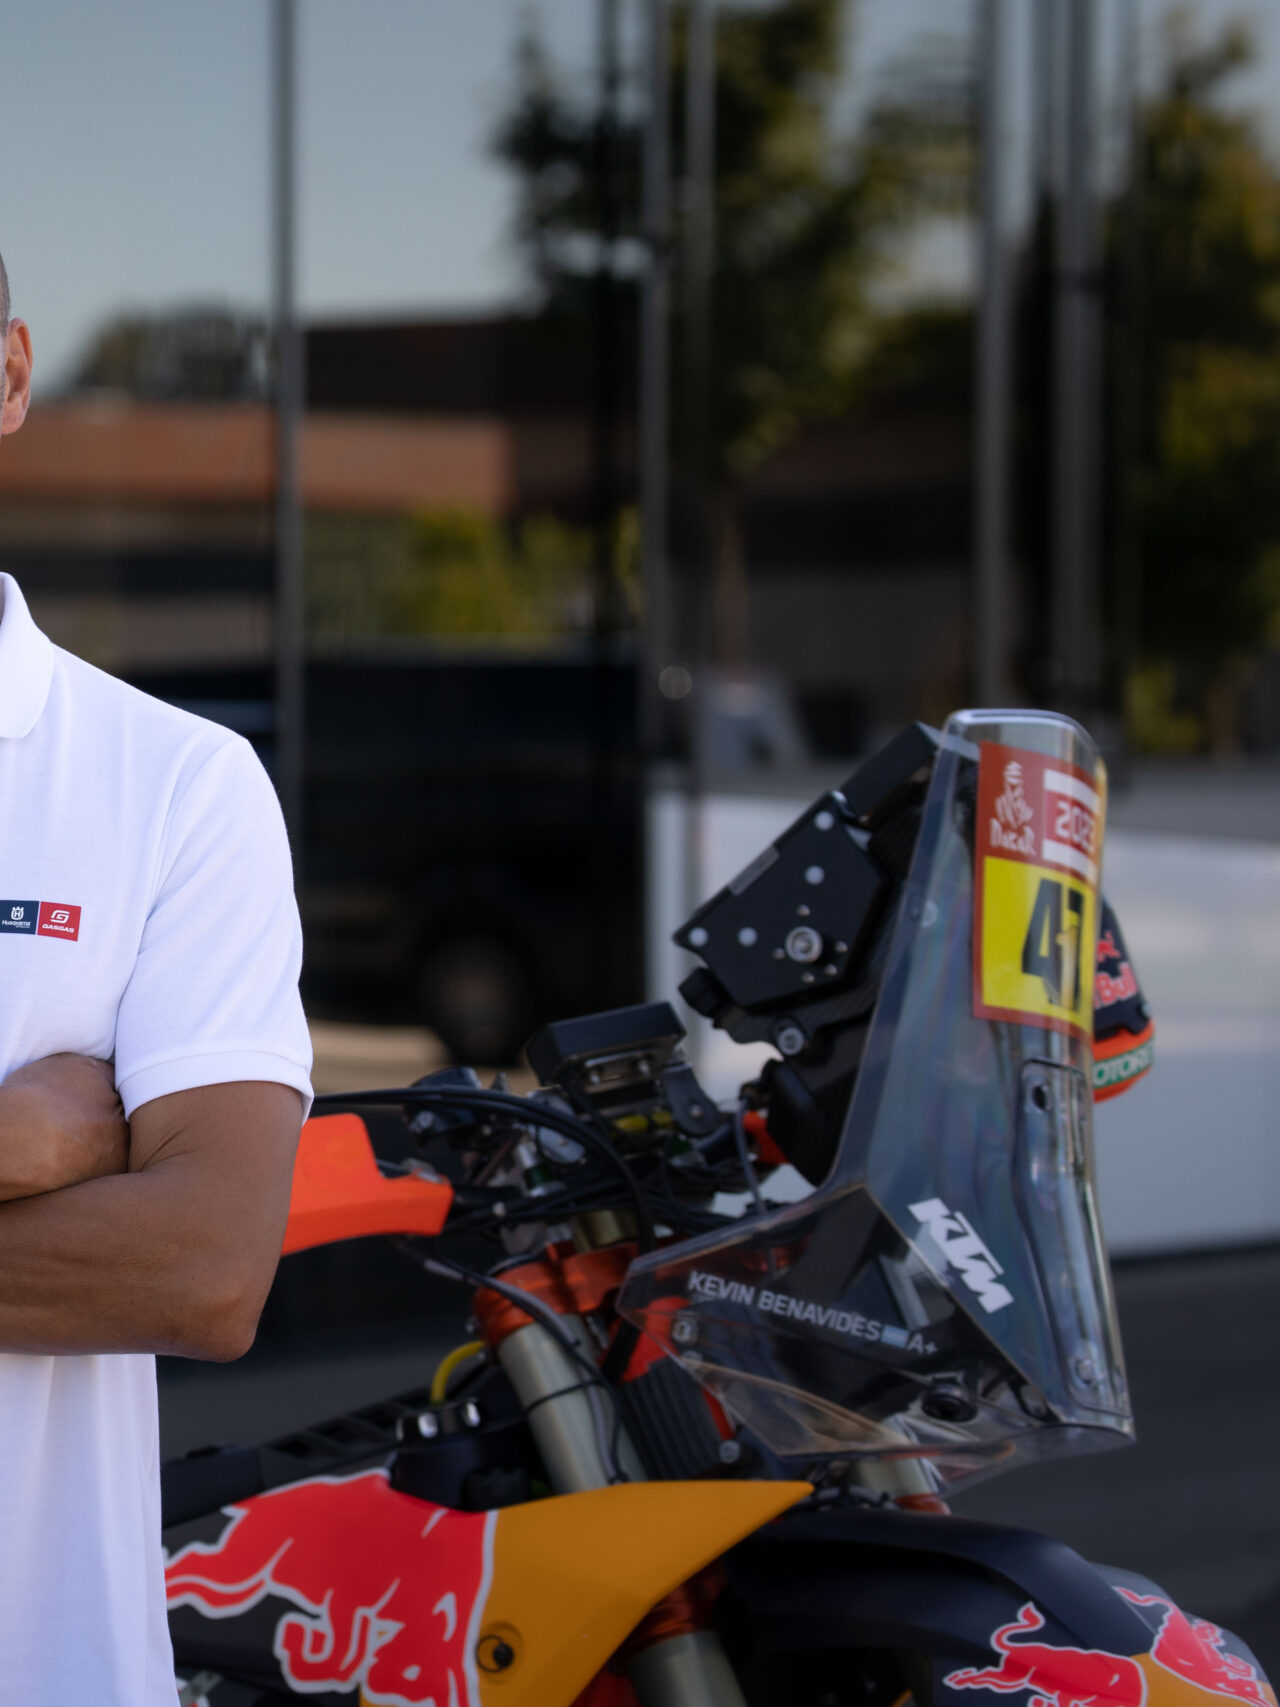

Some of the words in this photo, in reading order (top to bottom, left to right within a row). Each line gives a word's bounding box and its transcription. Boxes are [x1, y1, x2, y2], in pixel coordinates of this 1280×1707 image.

[42, 924, 74, 933] GASGAS
[1022, 878, 1083, 1015] 47
[908, 1198, 1014, 1314] KTM
[687, 1270, 755, 1306] KEVIN
[759, 1289, 882, 1341] BENAVIDES
[907, 1335, 938, 1355] A+
